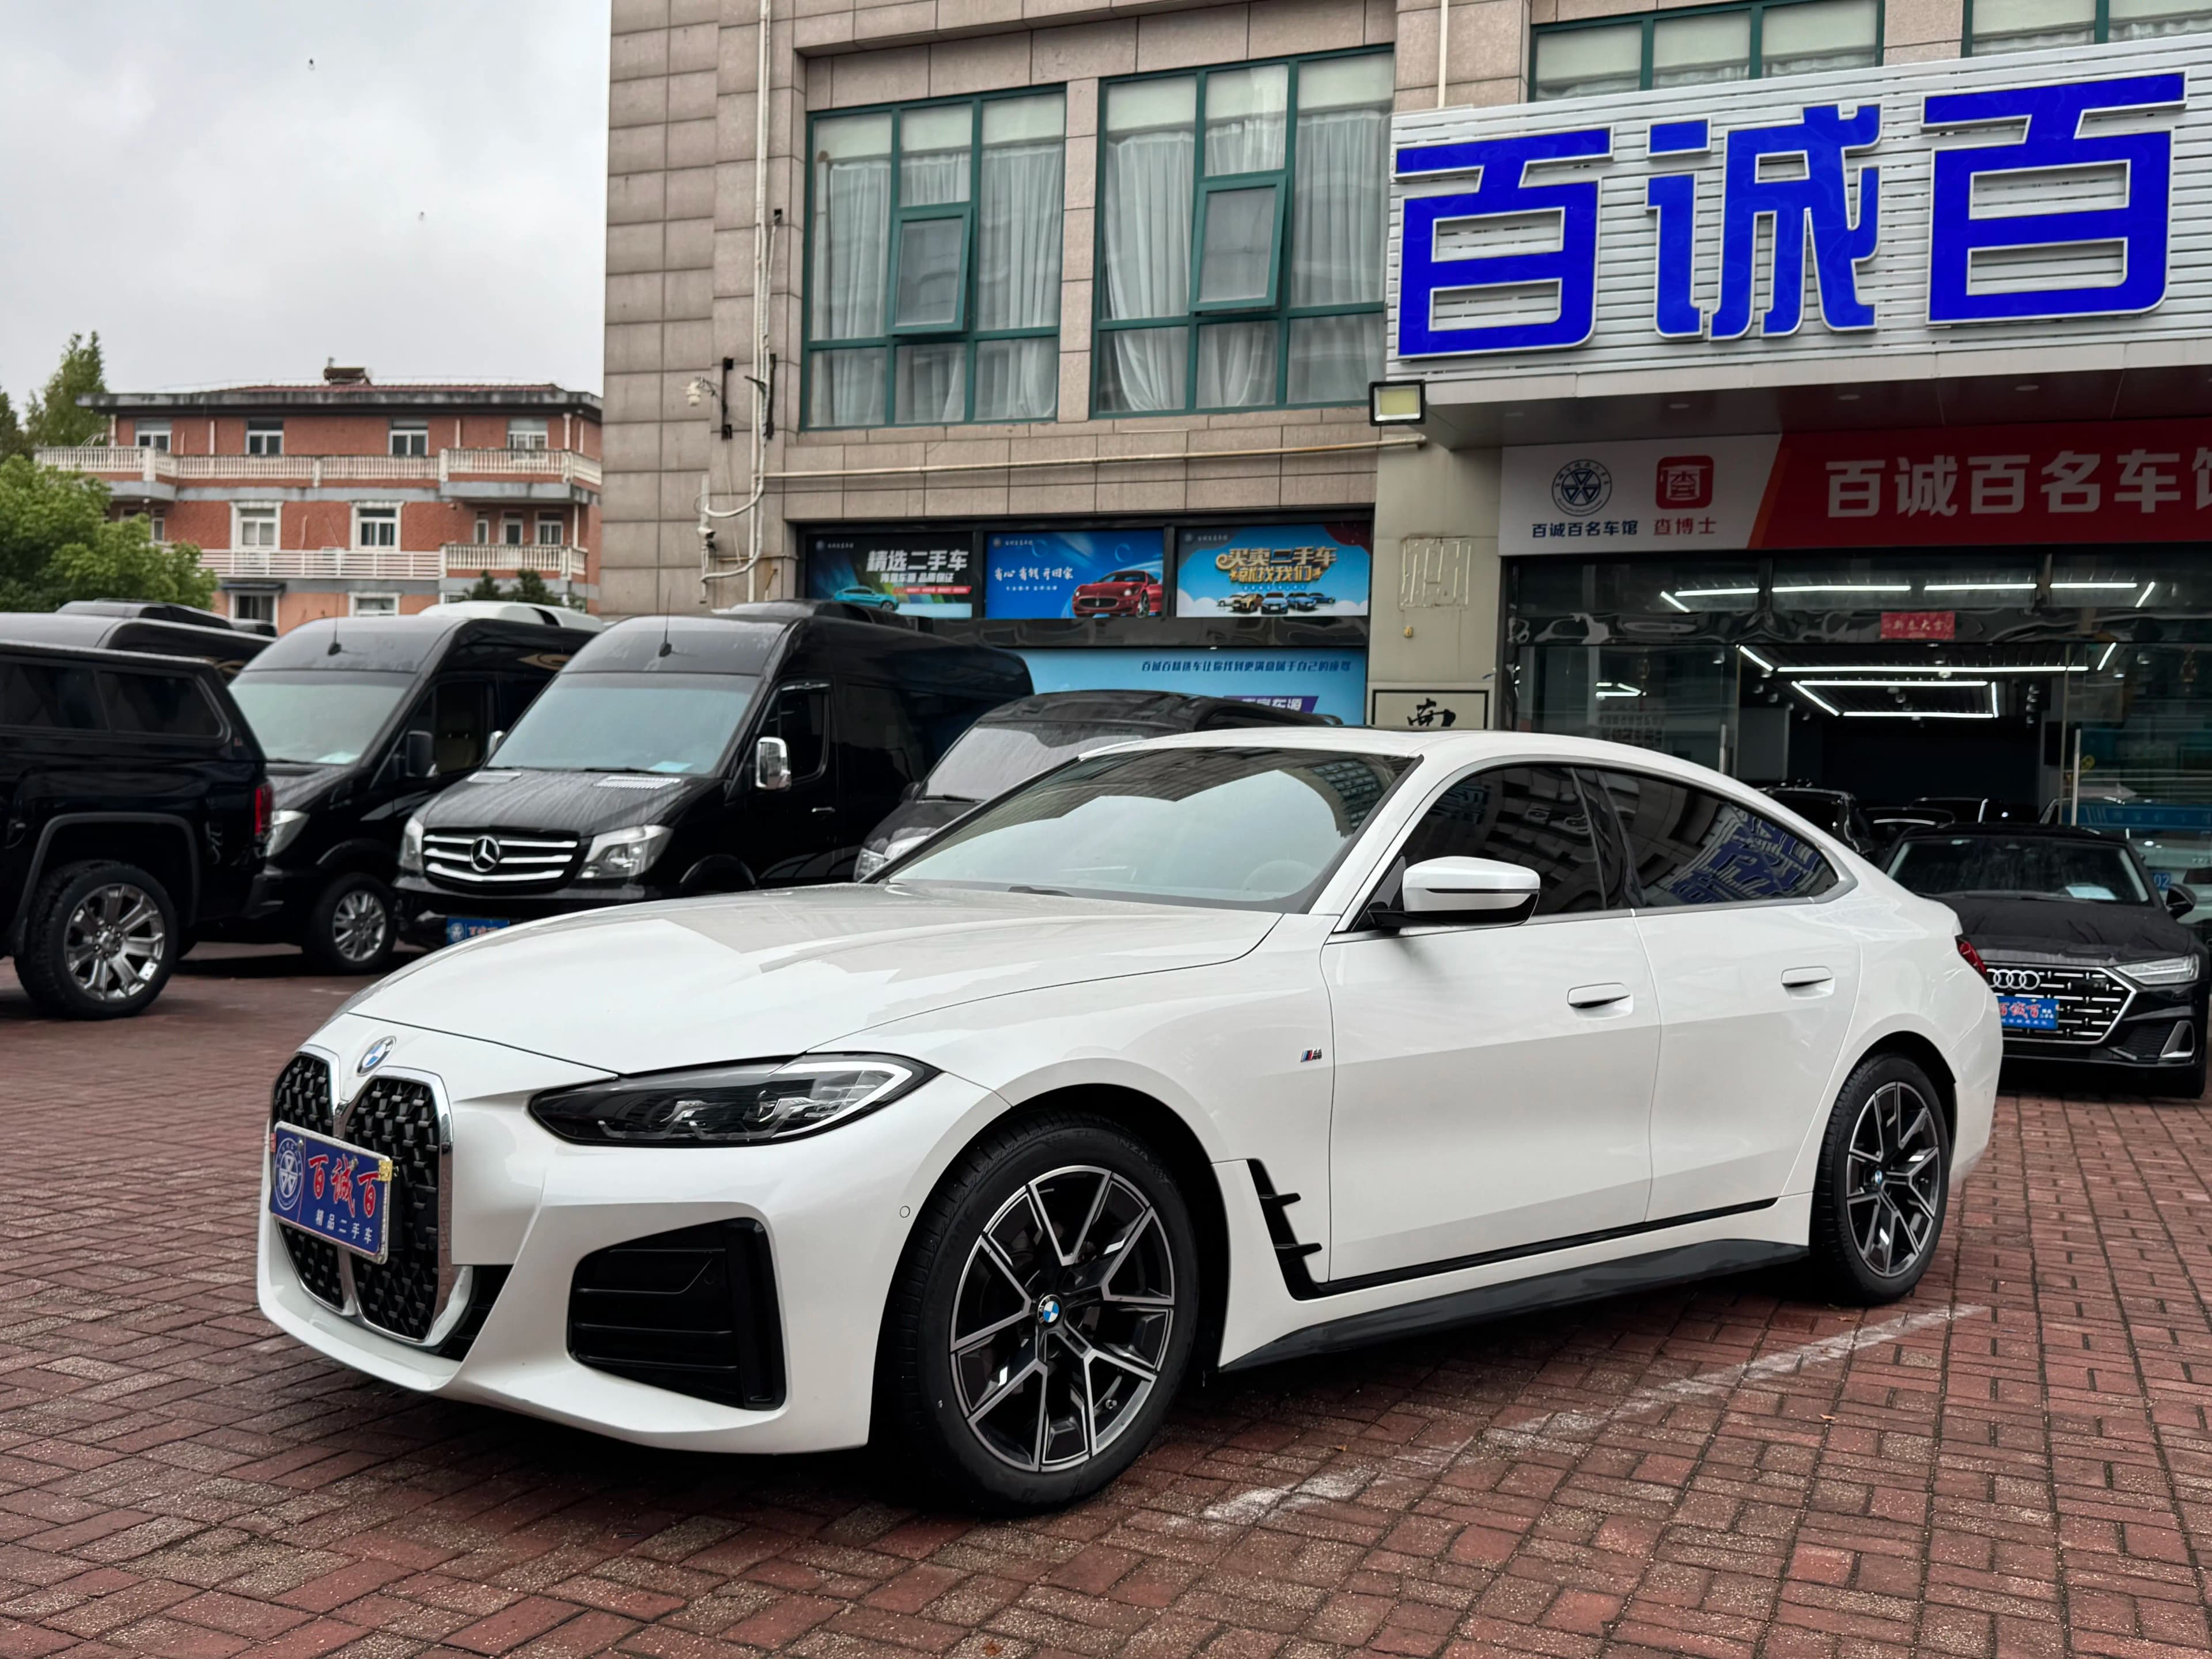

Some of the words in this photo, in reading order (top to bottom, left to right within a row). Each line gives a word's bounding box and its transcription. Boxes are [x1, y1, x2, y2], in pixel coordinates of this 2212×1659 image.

[1391, 71, 2188, 362] 百诚百
[1532, 520, 1639, 538] 百诚百名车馆
[1654, 517, 1717, 536] 查博士
[866, 550, 969, 571] 精选二手车
[1215, 546, 1338, 570] 买卖二手车
[1238, 565, 1313, 582] 就找我们
[1242, 698, 1303, 711] 车源
[315, 1209, 373, 1244] 精品二手车
